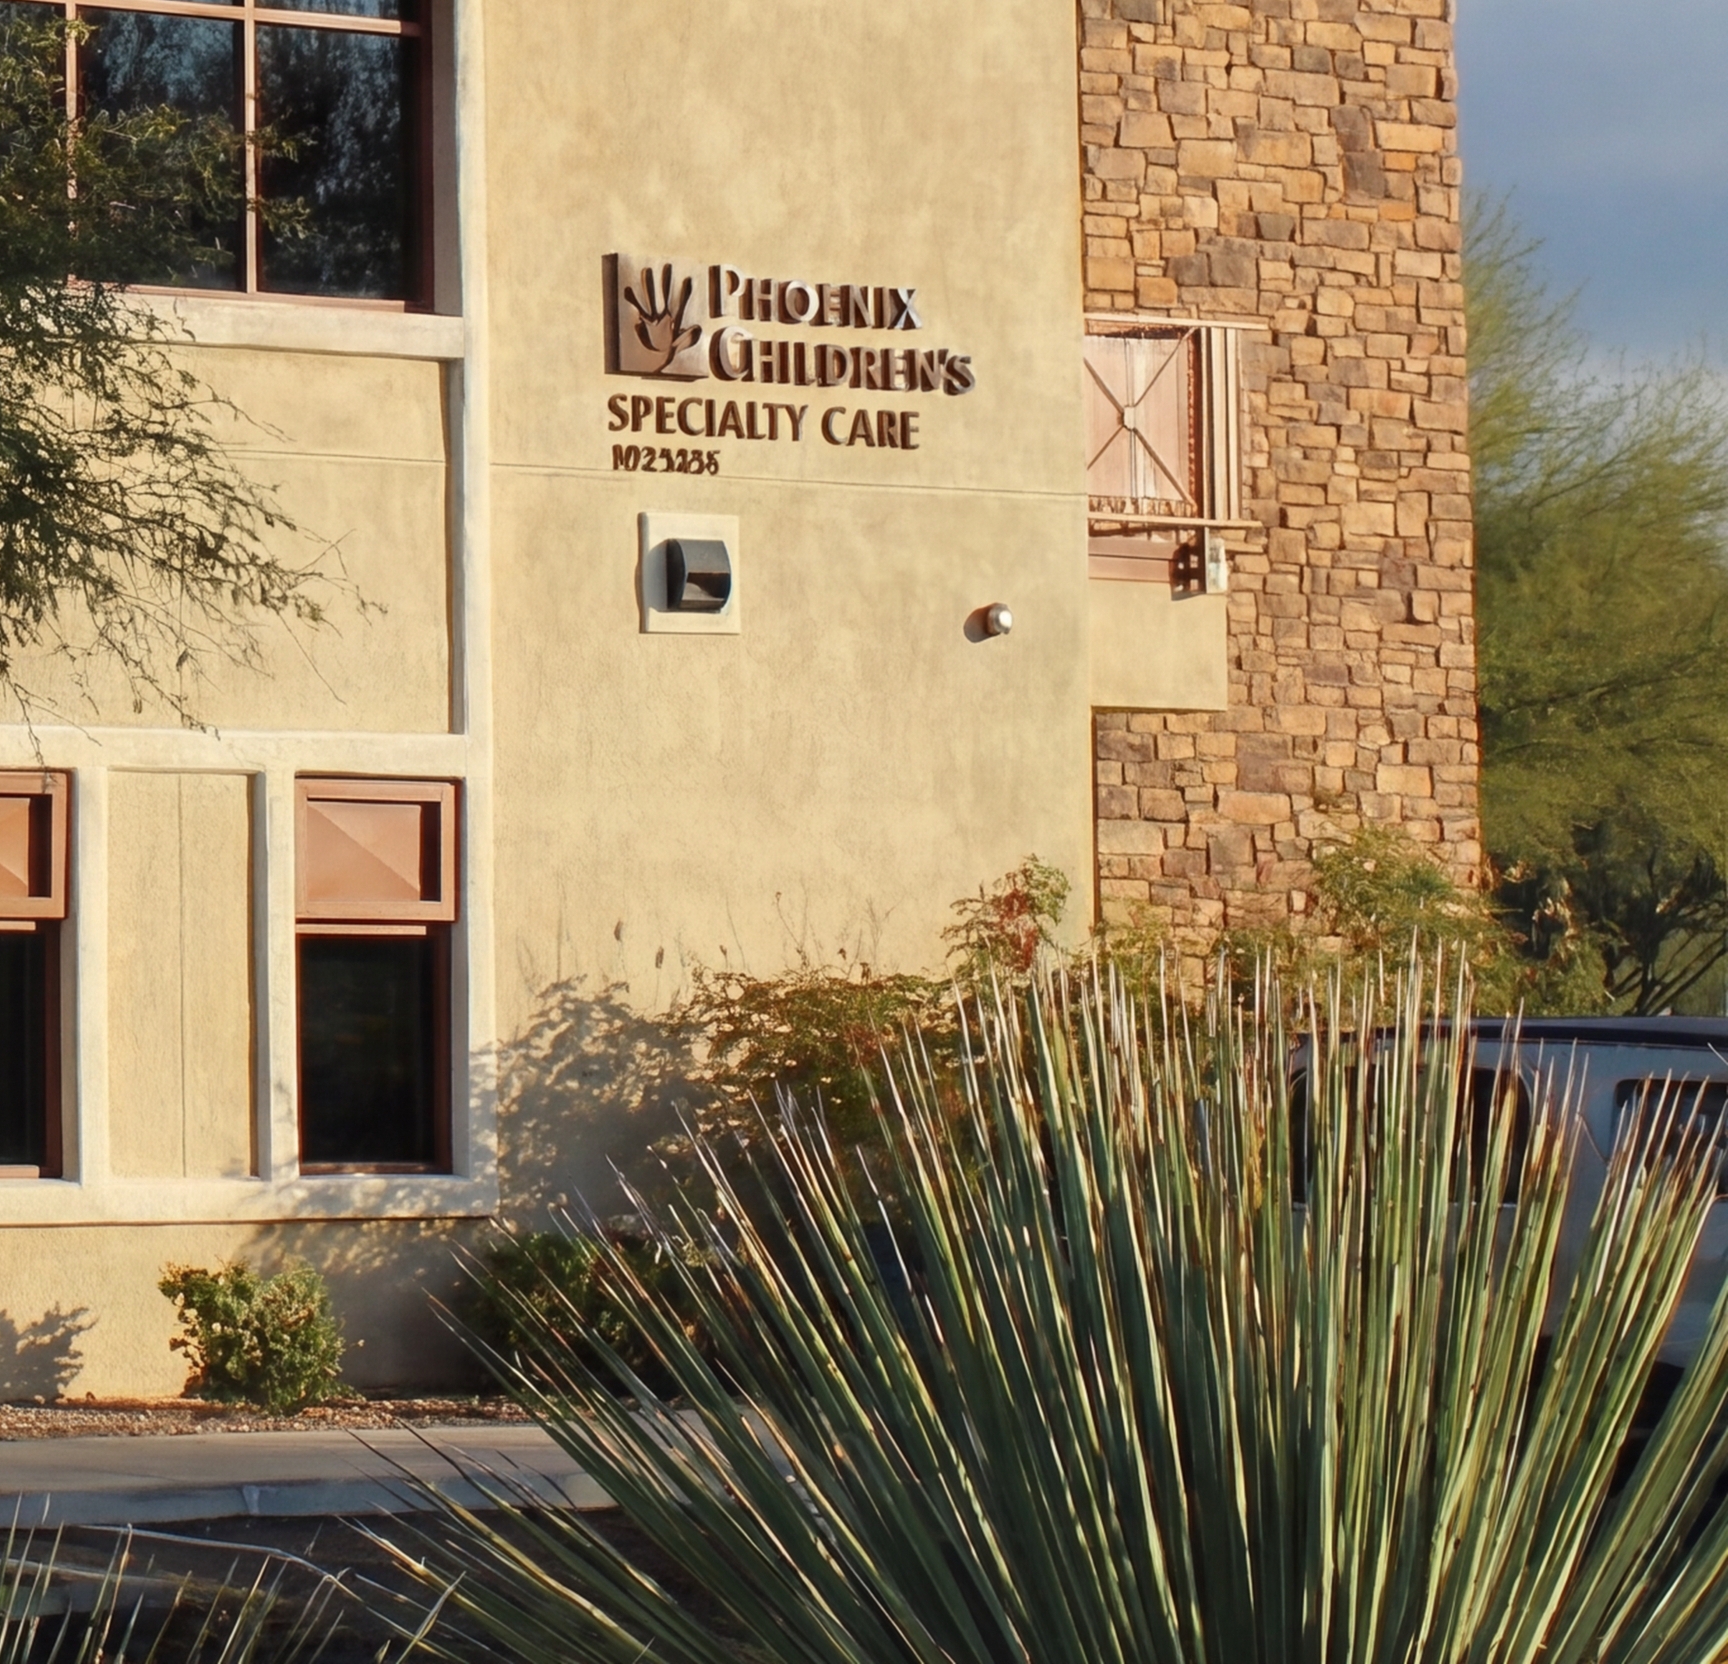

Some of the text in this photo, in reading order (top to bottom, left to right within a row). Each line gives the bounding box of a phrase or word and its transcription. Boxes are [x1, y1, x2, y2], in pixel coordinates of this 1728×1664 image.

[708, 264, 923, 331] PHOENIX
[607, 393, 921, 450] SPECIALTY CARE
